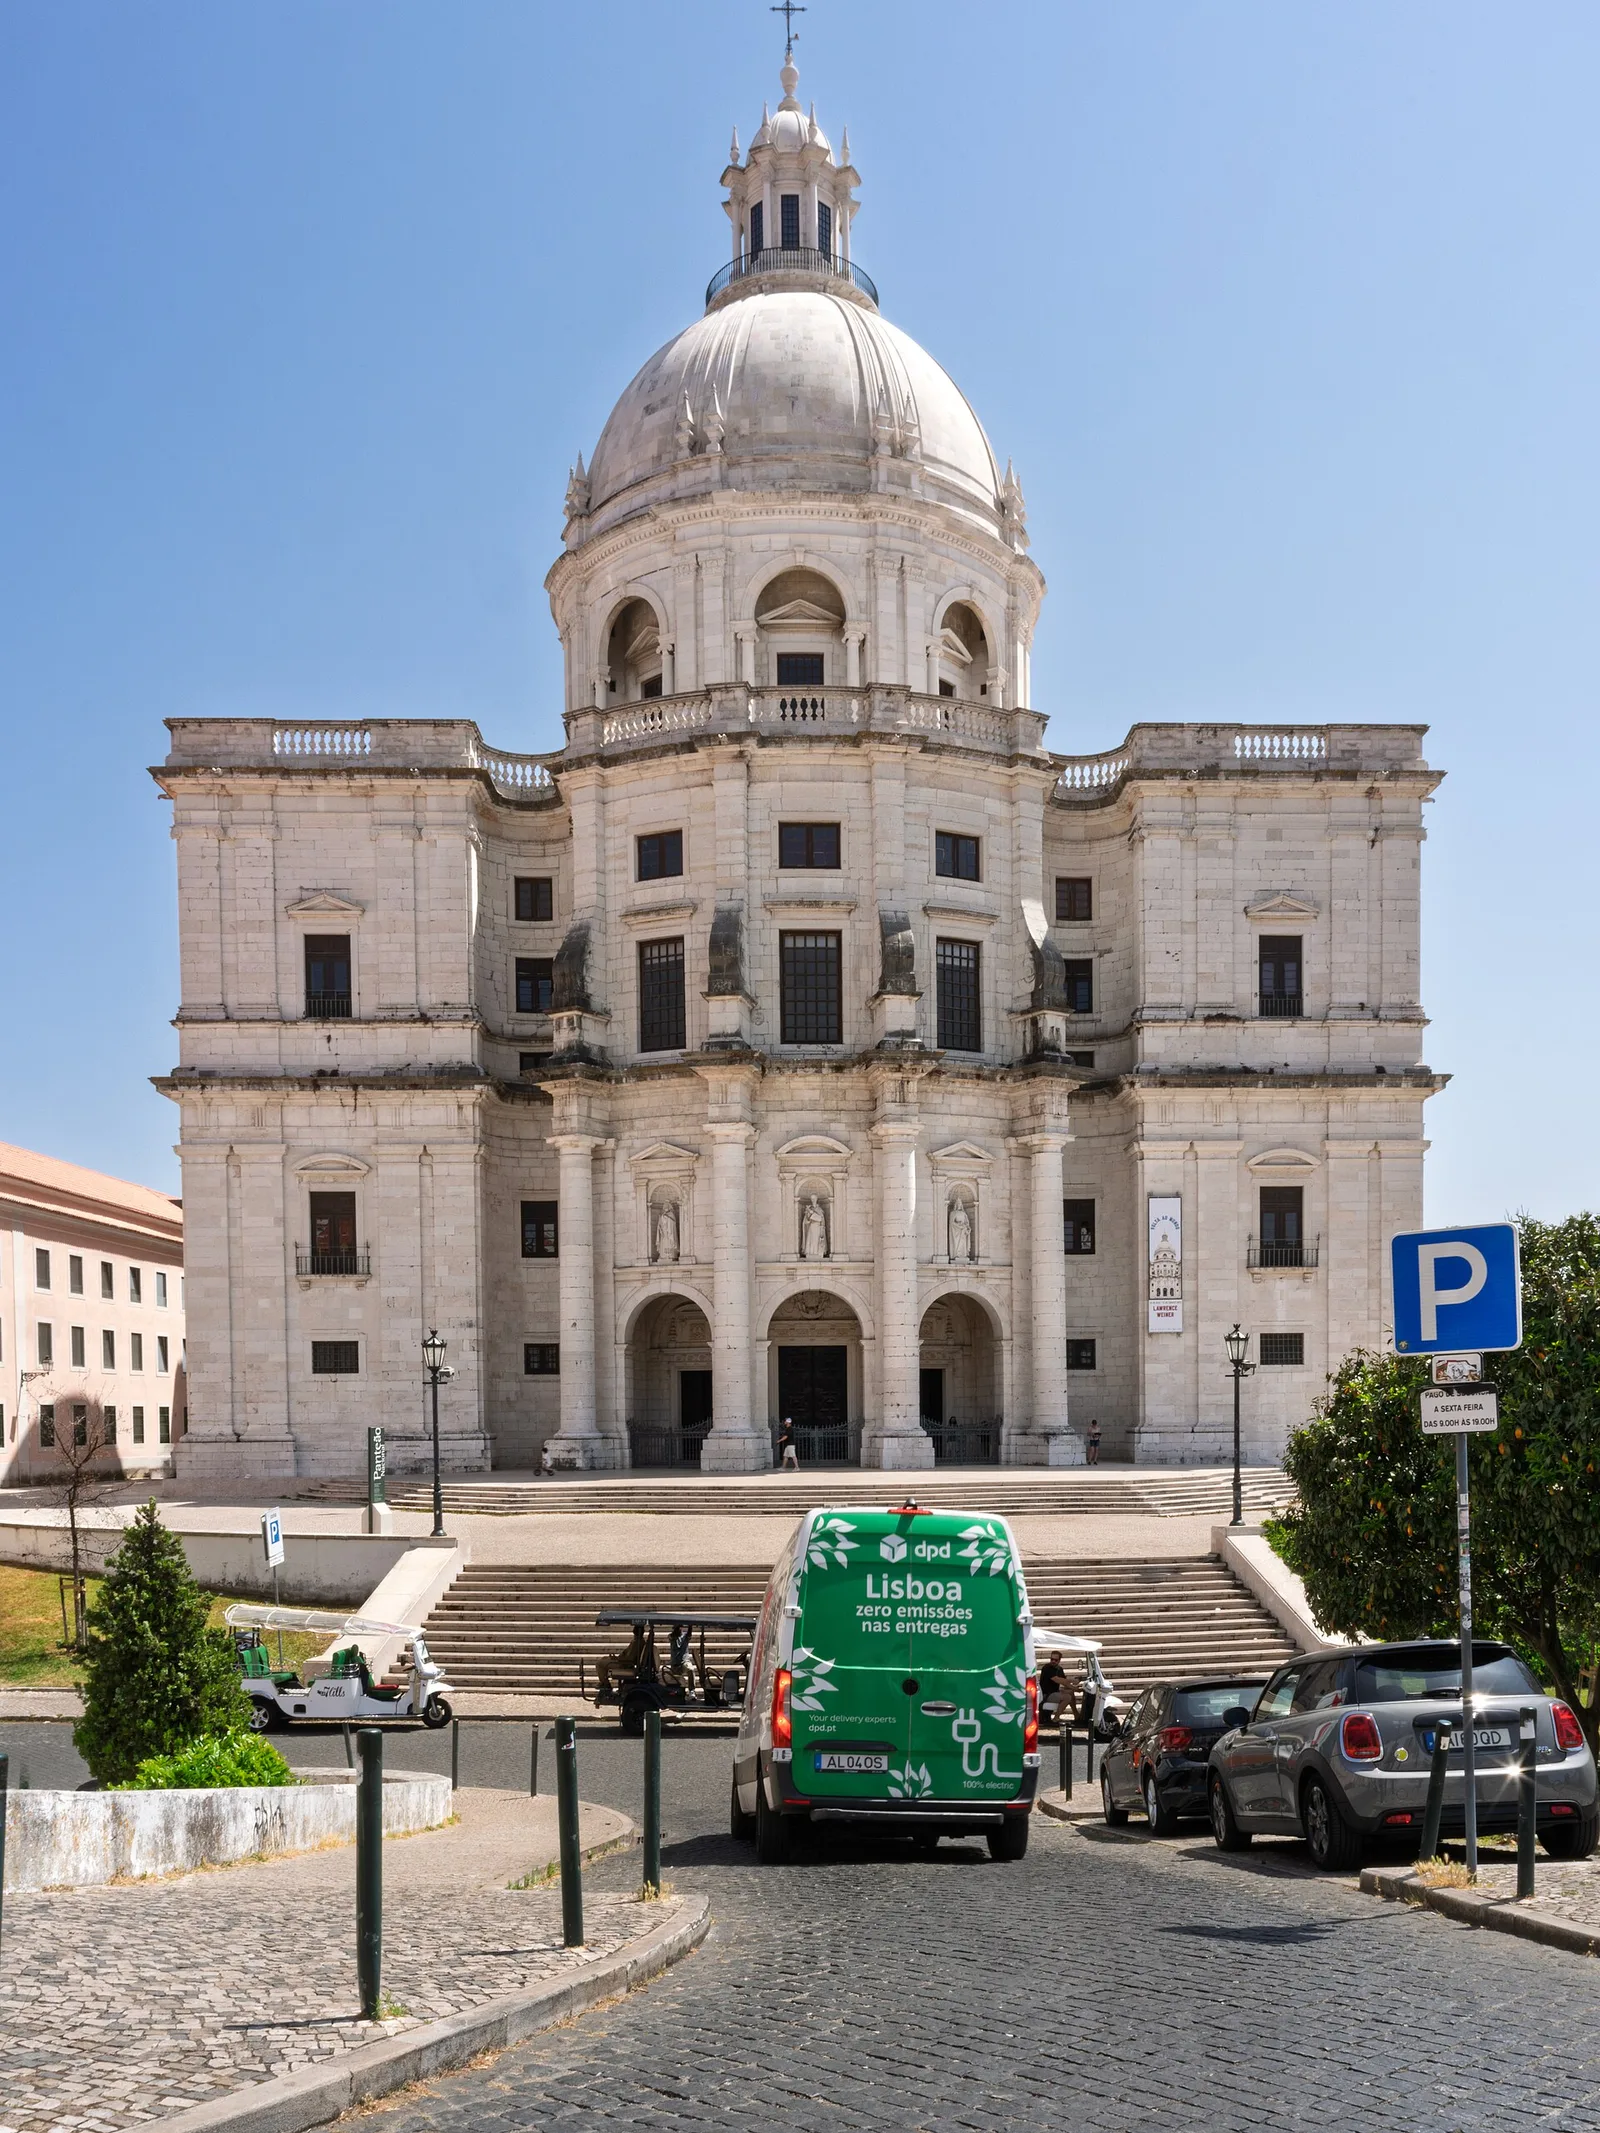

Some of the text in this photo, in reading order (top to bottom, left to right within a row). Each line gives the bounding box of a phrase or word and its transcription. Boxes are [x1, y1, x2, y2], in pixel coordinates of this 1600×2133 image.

[1418, 1241, 1488, 1341] P
[1424, 1390, 1444, 1398] PAGO
[1440, 1404, 1462, 1412] SEXTA
[374, 1428, 382, 1480] Panteão
[272, 1522, 278, 1542] P
[914, 1540, 950, 1562] dpd
[866, 1573, 962, 1601] Lisboa
[856, 1604, 972, 1620] zero emissões
[862, 1620, 968, 1638] nas entregas
[808, 1724, 836, 1732] dpd.pt
[809, 1714, 896, 1725] Your delivery experts
[962, 1780, 1014, 1790] 100% electric
